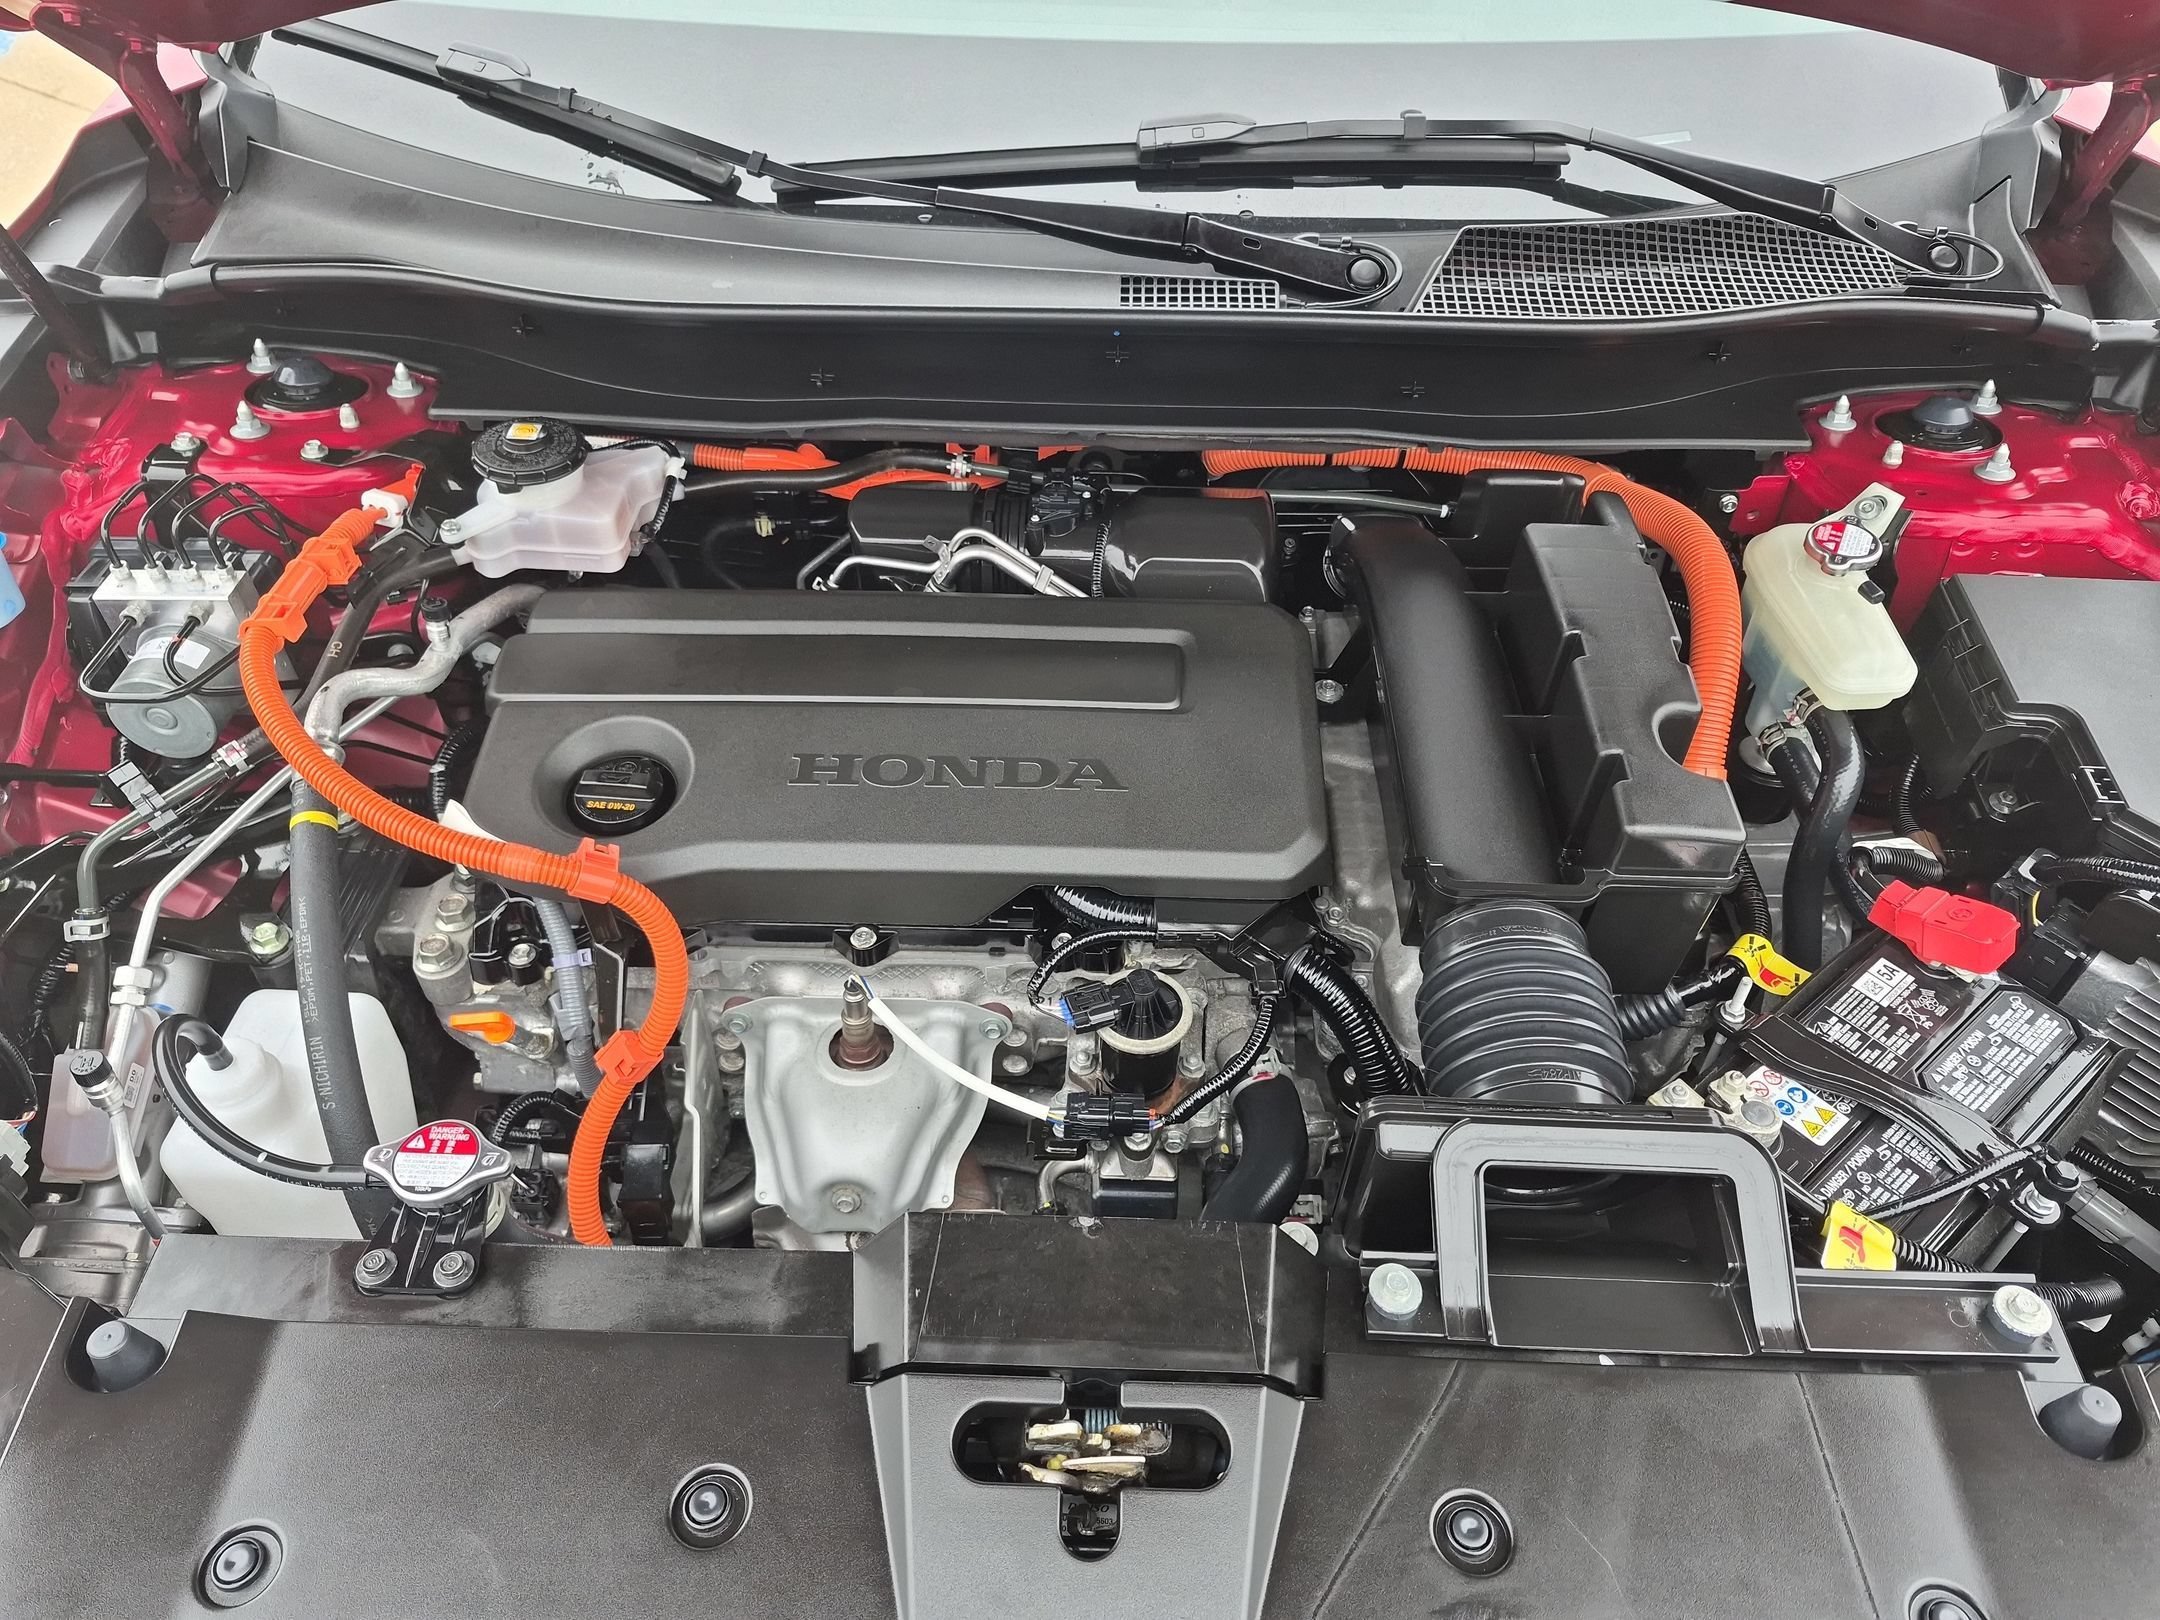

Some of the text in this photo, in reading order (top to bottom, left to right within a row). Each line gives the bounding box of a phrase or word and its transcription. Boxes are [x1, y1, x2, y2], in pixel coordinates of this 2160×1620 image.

[788, 754, 1130, 793] HONDA
[586, 800, 636, 811] SAE 0W-20
[1877, 964, 1900, 981] 5A
[1938, 1051, 1963, 1077] DANGER
[1963, 1029, 1986, 1053] POISON
[431, 1126, 465, 1134] DANGER
[1820, 1169, 1850, 1198] DANGER
[1848, 1144, 1874, 1170] POISON
